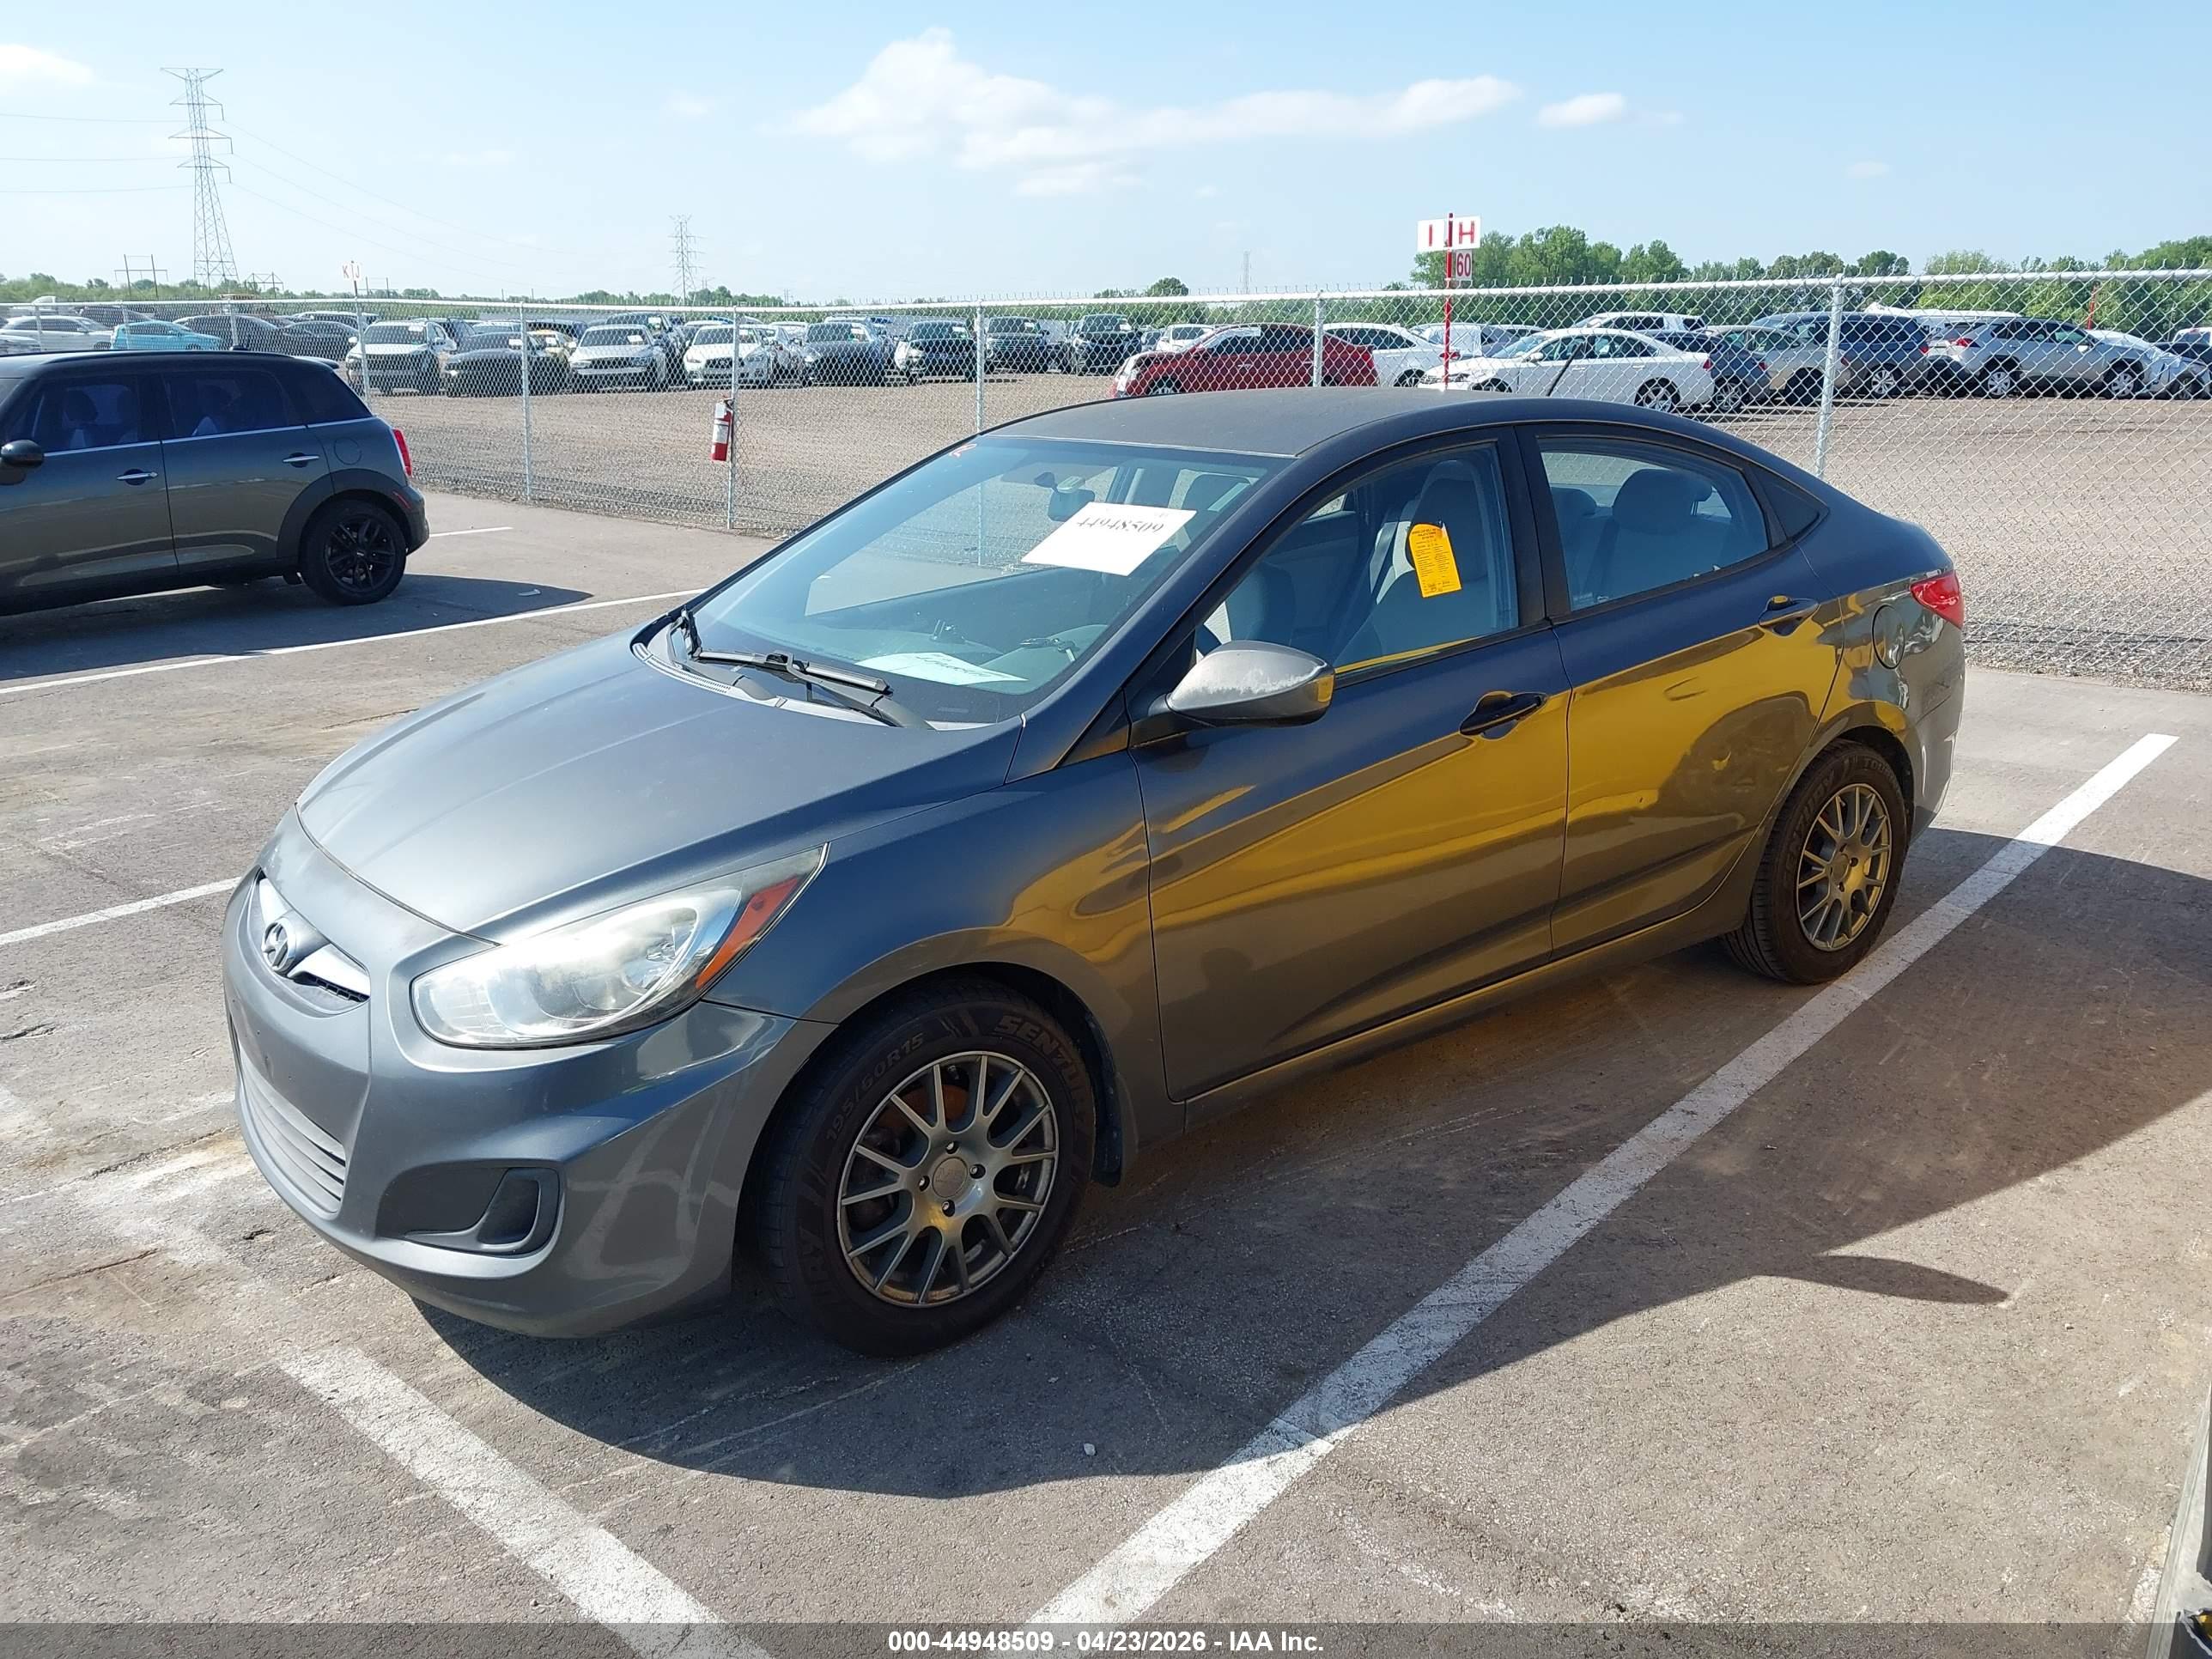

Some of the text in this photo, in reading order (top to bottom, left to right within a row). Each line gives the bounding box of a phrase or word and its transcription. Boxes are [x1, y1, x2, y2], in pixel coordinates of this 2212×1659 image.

[1458, 220, 1475, 245] H
[1455, 252, 1472, 277] 60
[1077, 516, 1165, 533] 44948509
[824, 1031, 927, 1141] 195/60R15
